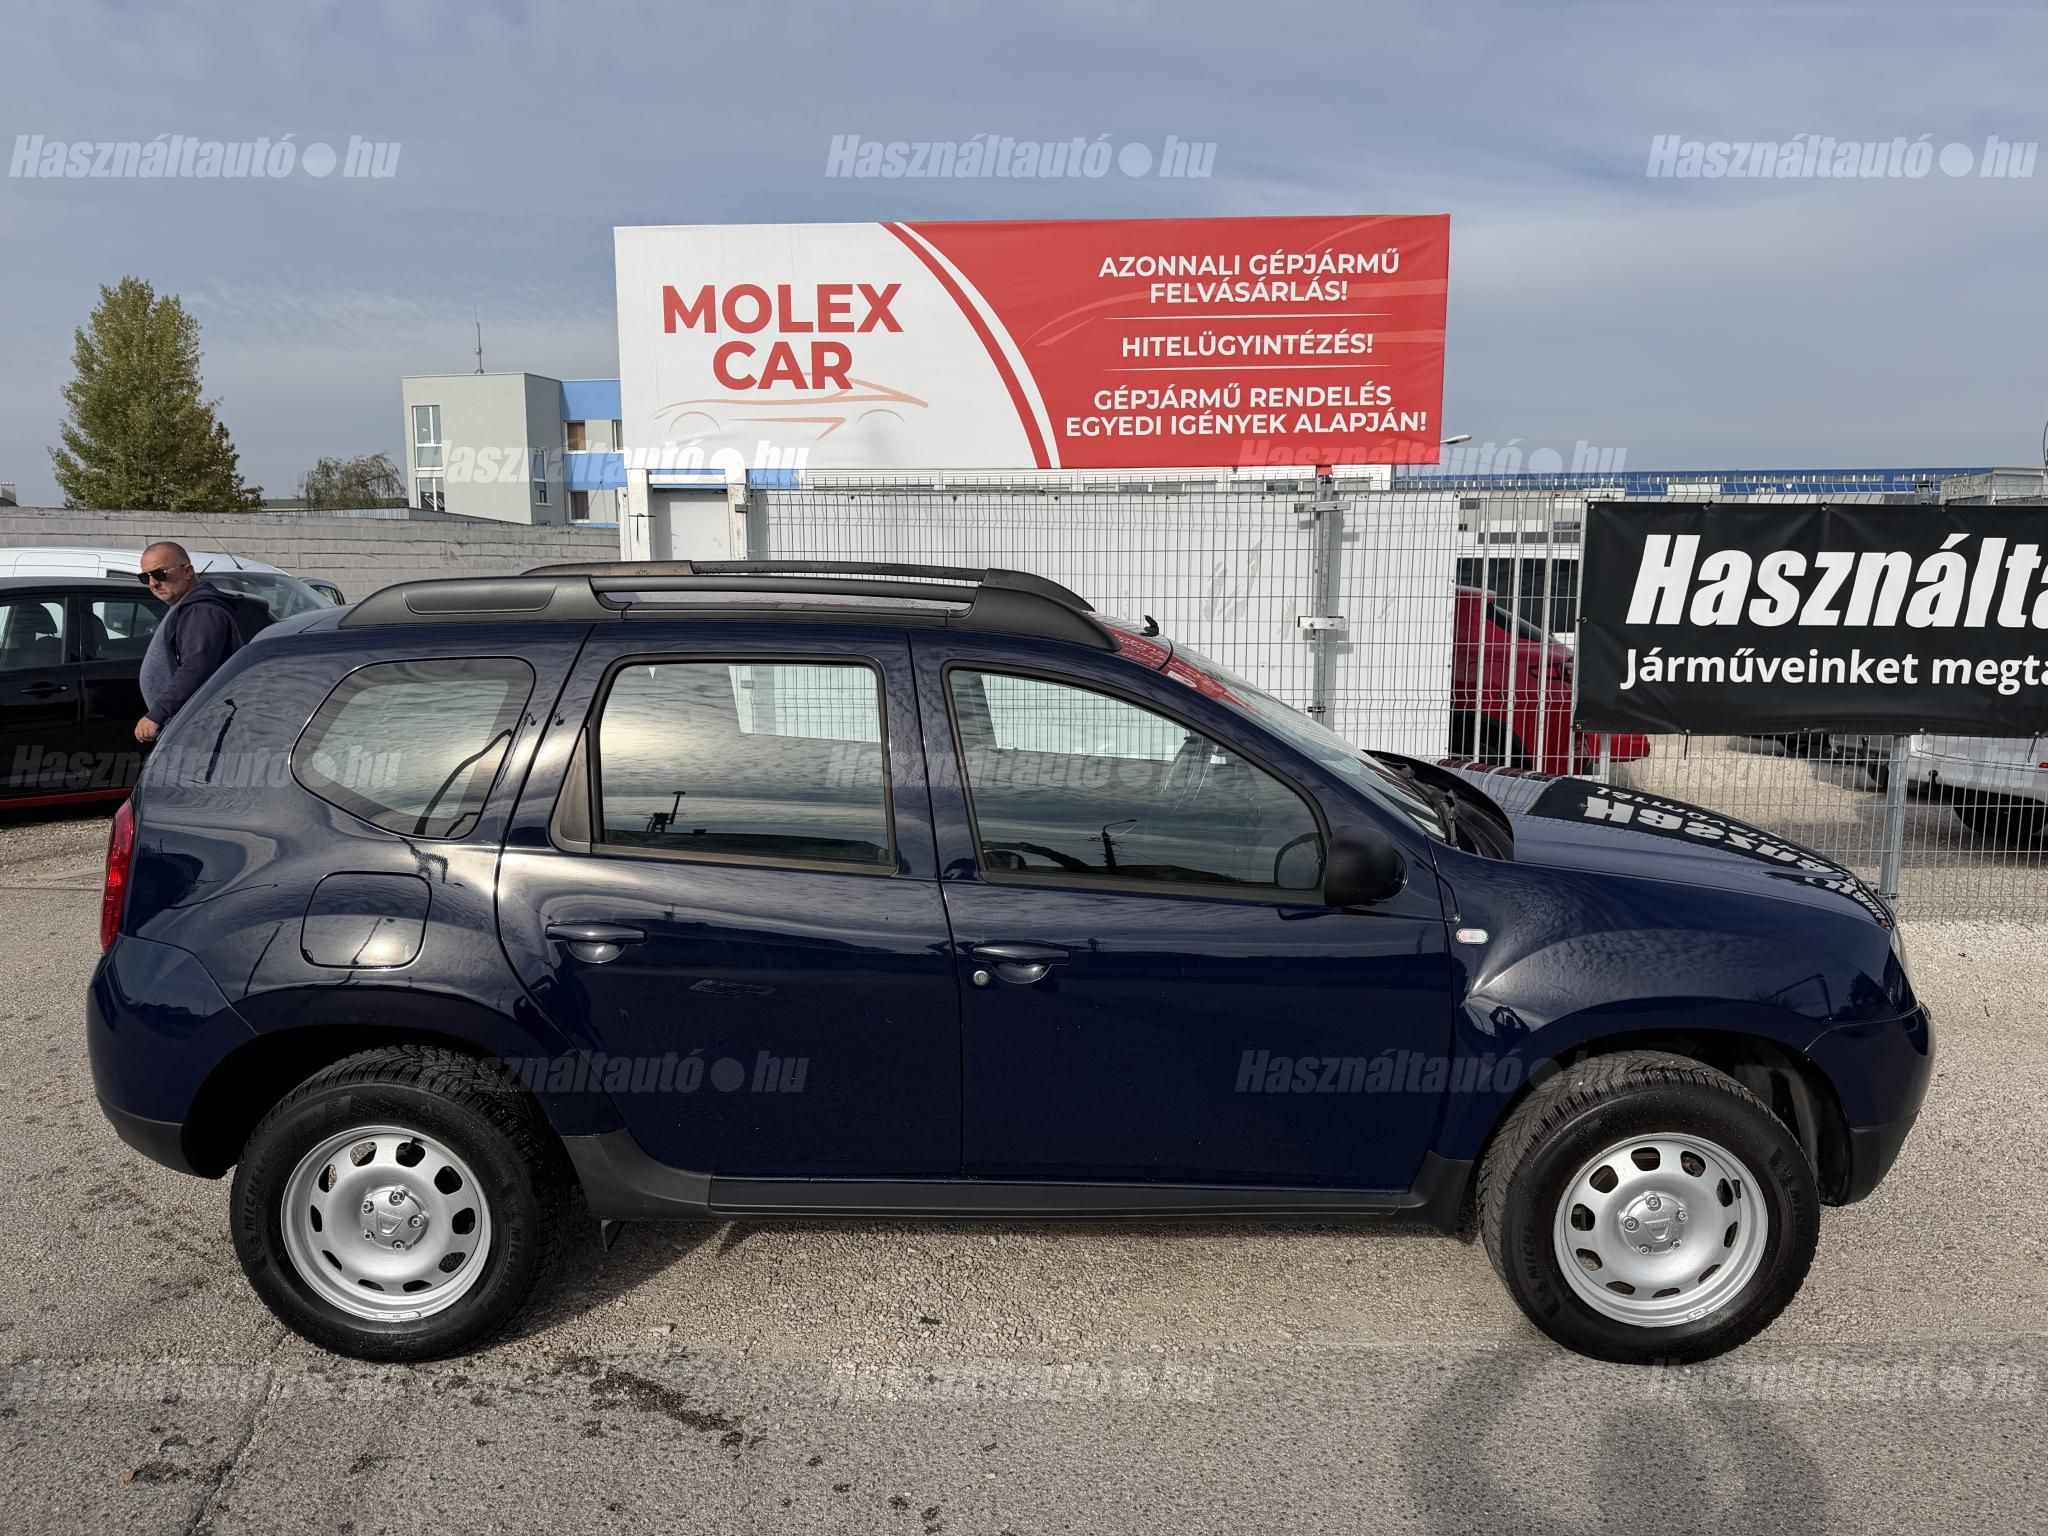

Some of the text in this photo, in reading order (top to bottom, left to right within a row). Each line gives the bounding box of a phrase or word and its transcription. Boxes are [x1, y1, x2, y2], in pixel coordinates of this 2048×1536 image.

[1098, 249, 1400, 278] AZONNALI GÉPJÁRMŰ
[1150, 276, 1348, 304] FELVÁSÁRLÁS!
[662, 283, 904, 334] MOLEX
[1121, 328, 1374, 358] HITELÜGYINTÉZÉS!
[713, 340, 853, 390] CAR
[1094, 381, 1392, 410] GÉPJÁRMŰ RENDELÉS
[1065, 407, 1427, 438] EGYEDI IGÉNYEK ALAPJÁN!
[1625, 533, 2048, 629] Használt
[1619, 646, 1919, 690] Járműveinket
